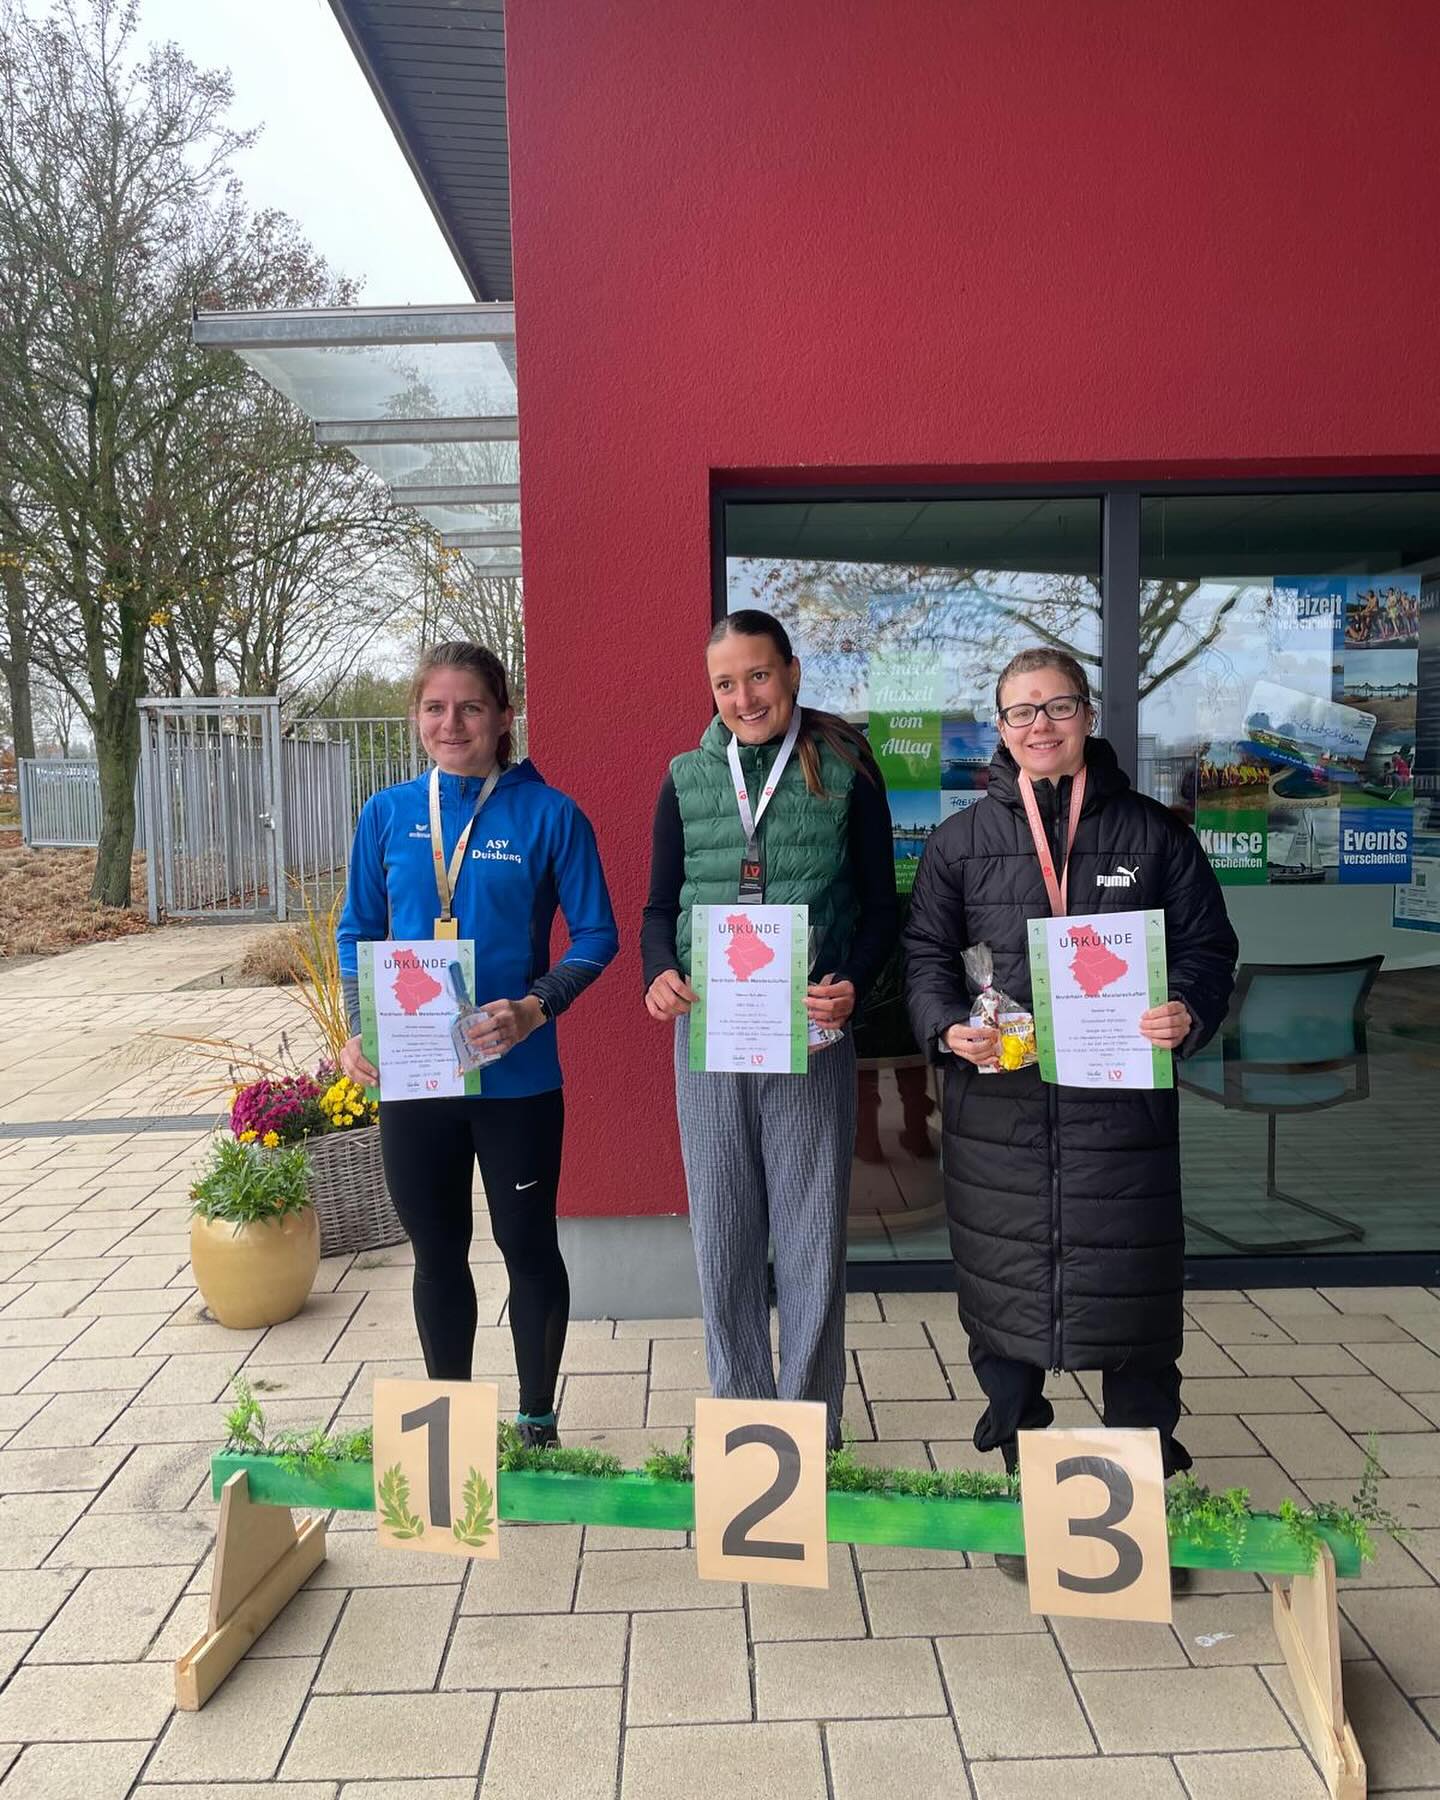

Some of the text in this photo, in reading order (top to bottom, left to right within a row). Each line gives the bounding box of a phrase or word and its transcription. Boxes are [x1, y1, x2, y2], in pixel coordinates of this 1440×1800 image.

[890, 716, 924, 729] vom
[881, 738, 934, 760] Alltag
[485, 840, 510, 849] ASV
[1200, 829, 1263, 854] Kurse
[1343, 828, 1408, 851] Events
[472, 849, 522, 864] Duisburg
[1210, 856, 1263, 869] rschenken
[1343, 853, 1408, 865] verschenken
[1096, 874, 1131, 888] PUMA
[718, 923, 781, 934] URKUNDE
[1059, 933, 1133, 948] URKUNDE
[384, 958, 448, 969] URKUNDE
[401, 1396, 452, 1528] 1
[722, 1423, 805, 1561] 2
[1055, 1455, 1143, 1594] 3
